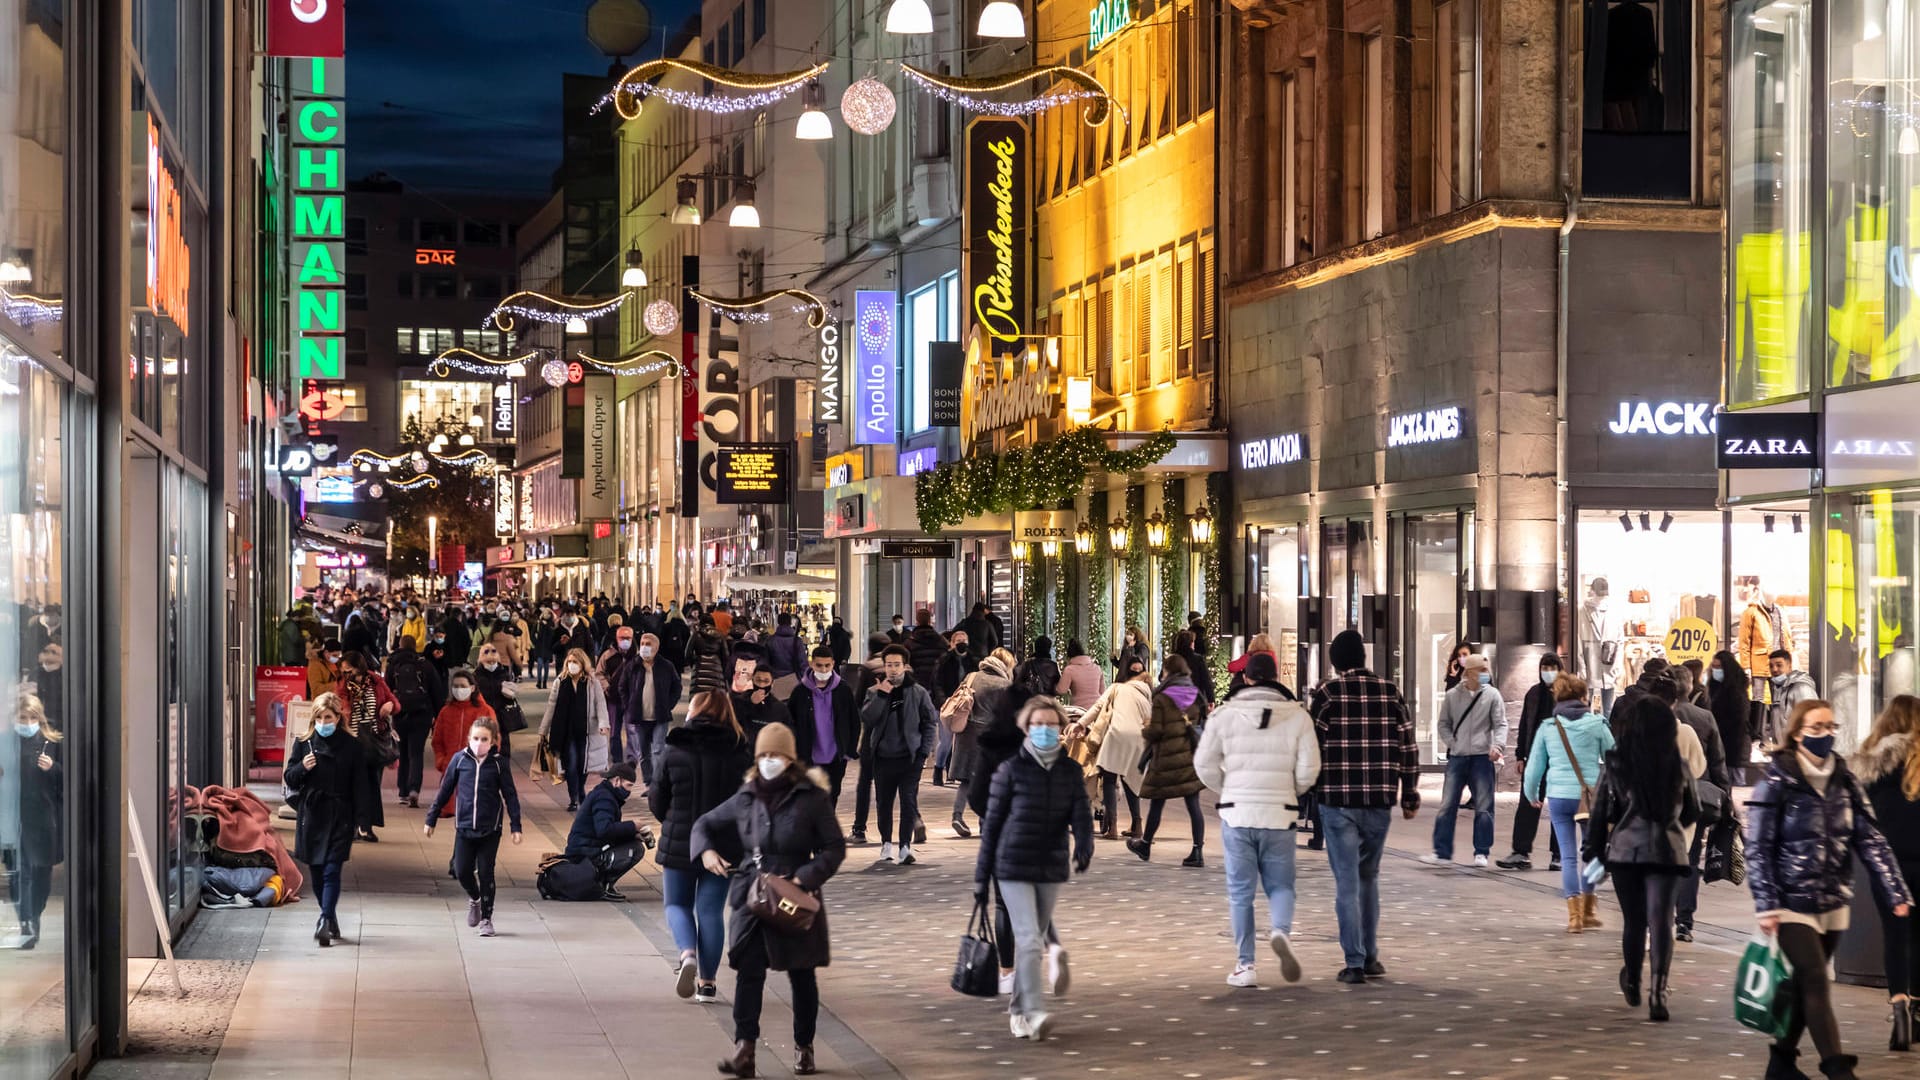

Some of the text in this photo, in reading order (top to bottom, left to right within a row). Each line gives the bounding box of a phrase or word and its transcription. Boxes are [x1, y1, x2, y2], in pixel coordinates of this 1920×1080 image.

[415, 249, 456, 265] DAK
[974, 136, 1020, 343] Rüschenbeck
[821, 325, 838, 420] MANGO
[867, 364, 890, 433] Apollo
[1388, 407, 1460, 447] JACK&JONES
[282, 450, 311, 471] JD
[592, 394, 608, 500] AppelrathCüpper
[1240, 433, 1302, 469] VERO MODA
[1724, 439, 1811, 455] ZARA
[1024, 527, 1066, 537] ROLEX
[902, 546, 934, 555] BONITA
[1671, 628, 1710, 652] 20%
[1744, 962, 1770, 998] D
